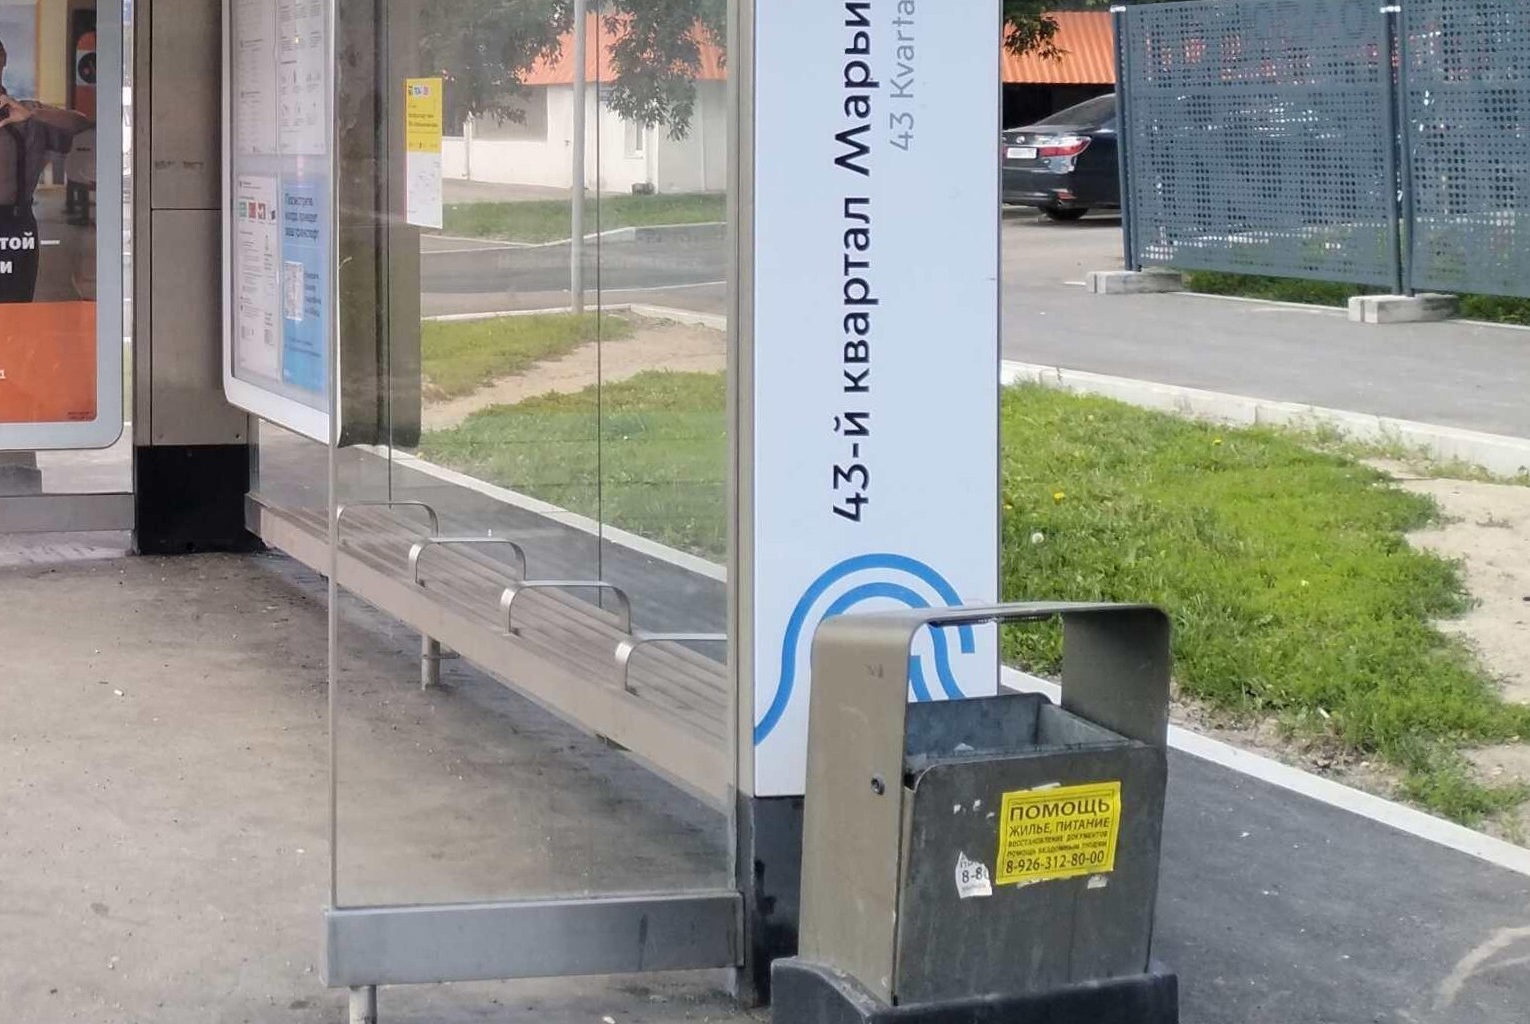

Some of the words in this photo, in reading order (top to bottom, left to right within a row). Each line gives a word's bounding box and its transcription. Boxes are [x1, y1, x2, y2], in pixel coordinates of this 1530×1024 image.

[890, 113, 914, 151] 43
[843, 197, 879, 393] квартал
[833, 412, 871, 523] 43-й
[1010, 798, 1110, 822] ПОМОЩЬ
[1056, 817, 1110, 832] ПИТАНИЕ
[1006, 850, 1105, 874] 8-926-312-80-00
